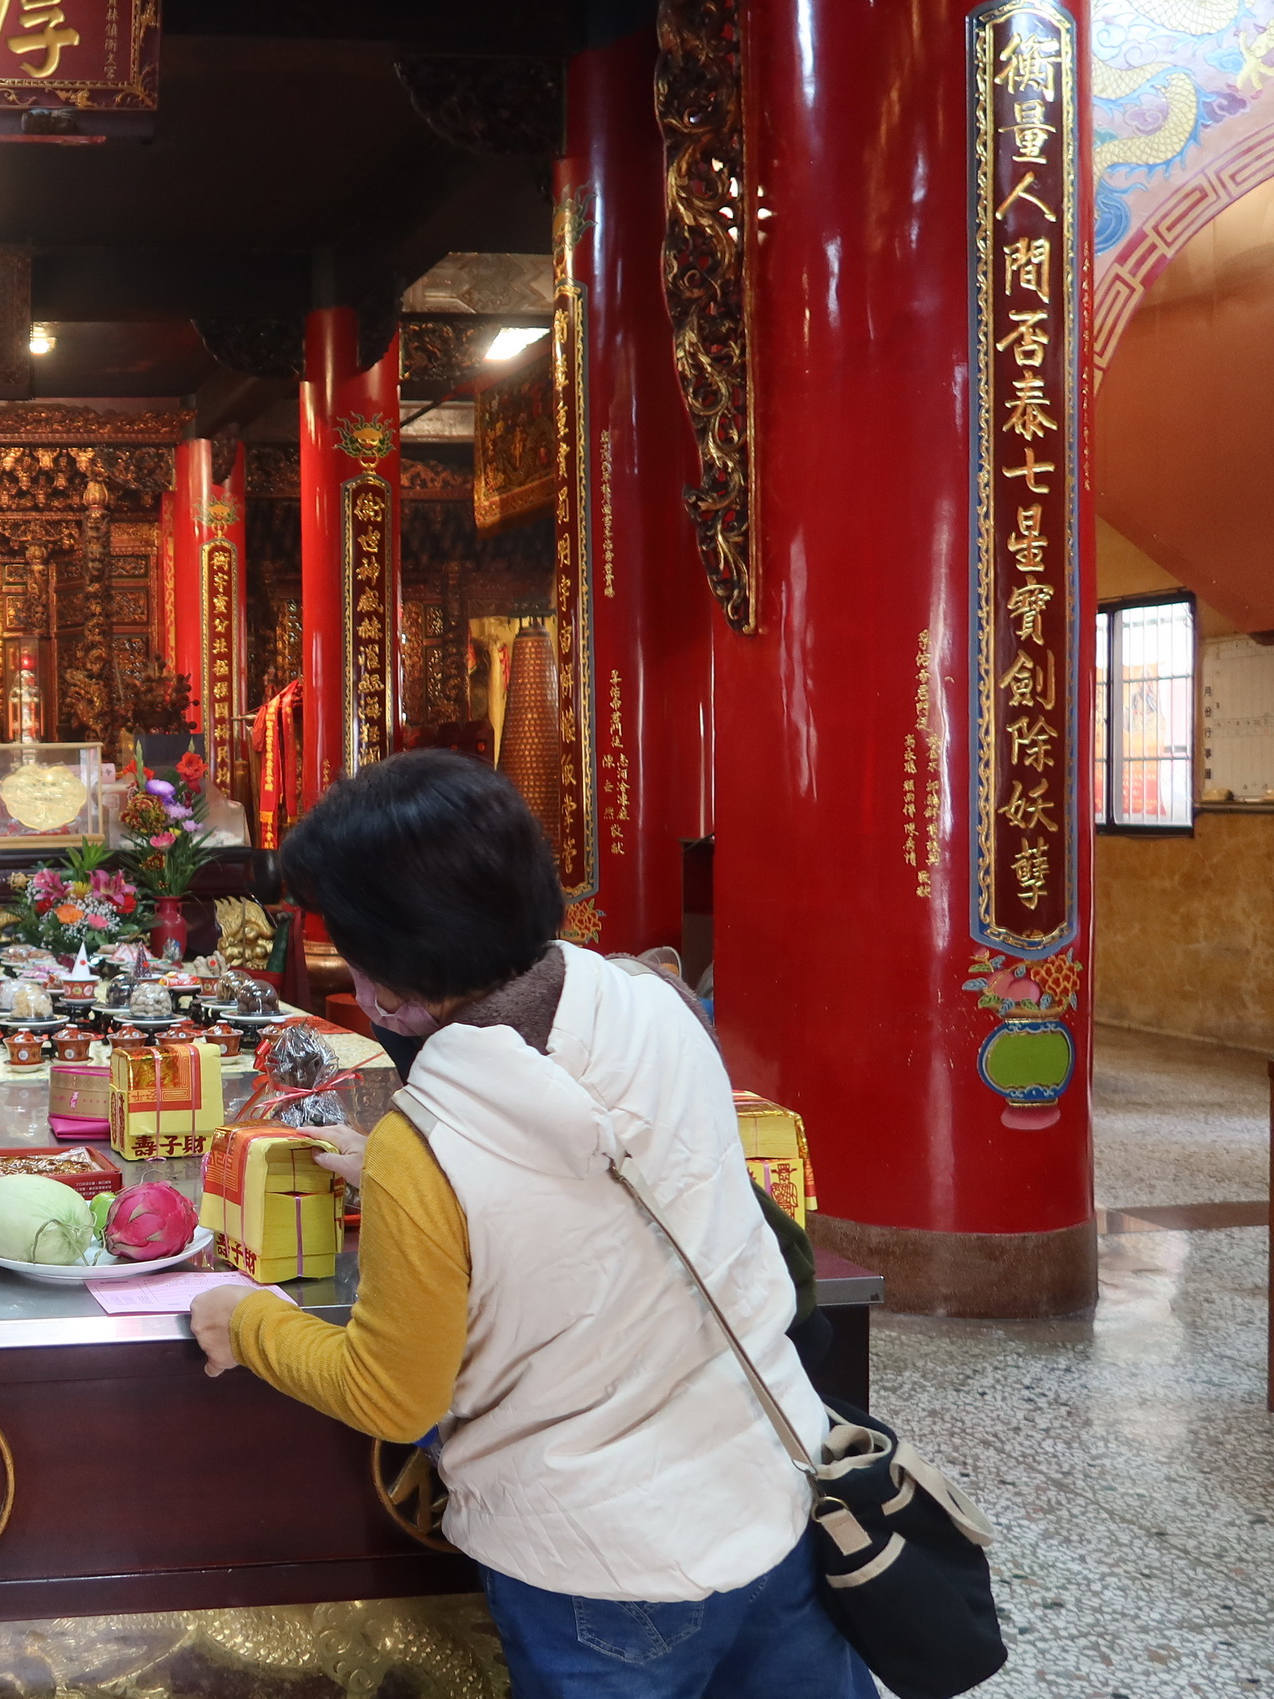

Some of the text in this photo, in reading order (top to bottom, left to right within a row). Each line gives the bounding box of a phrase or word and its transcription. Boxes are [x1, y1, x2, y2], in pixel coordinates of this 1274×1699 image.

[994, 32, 1062, 910] 衡量人間否泰七星寶劍除妖孽
